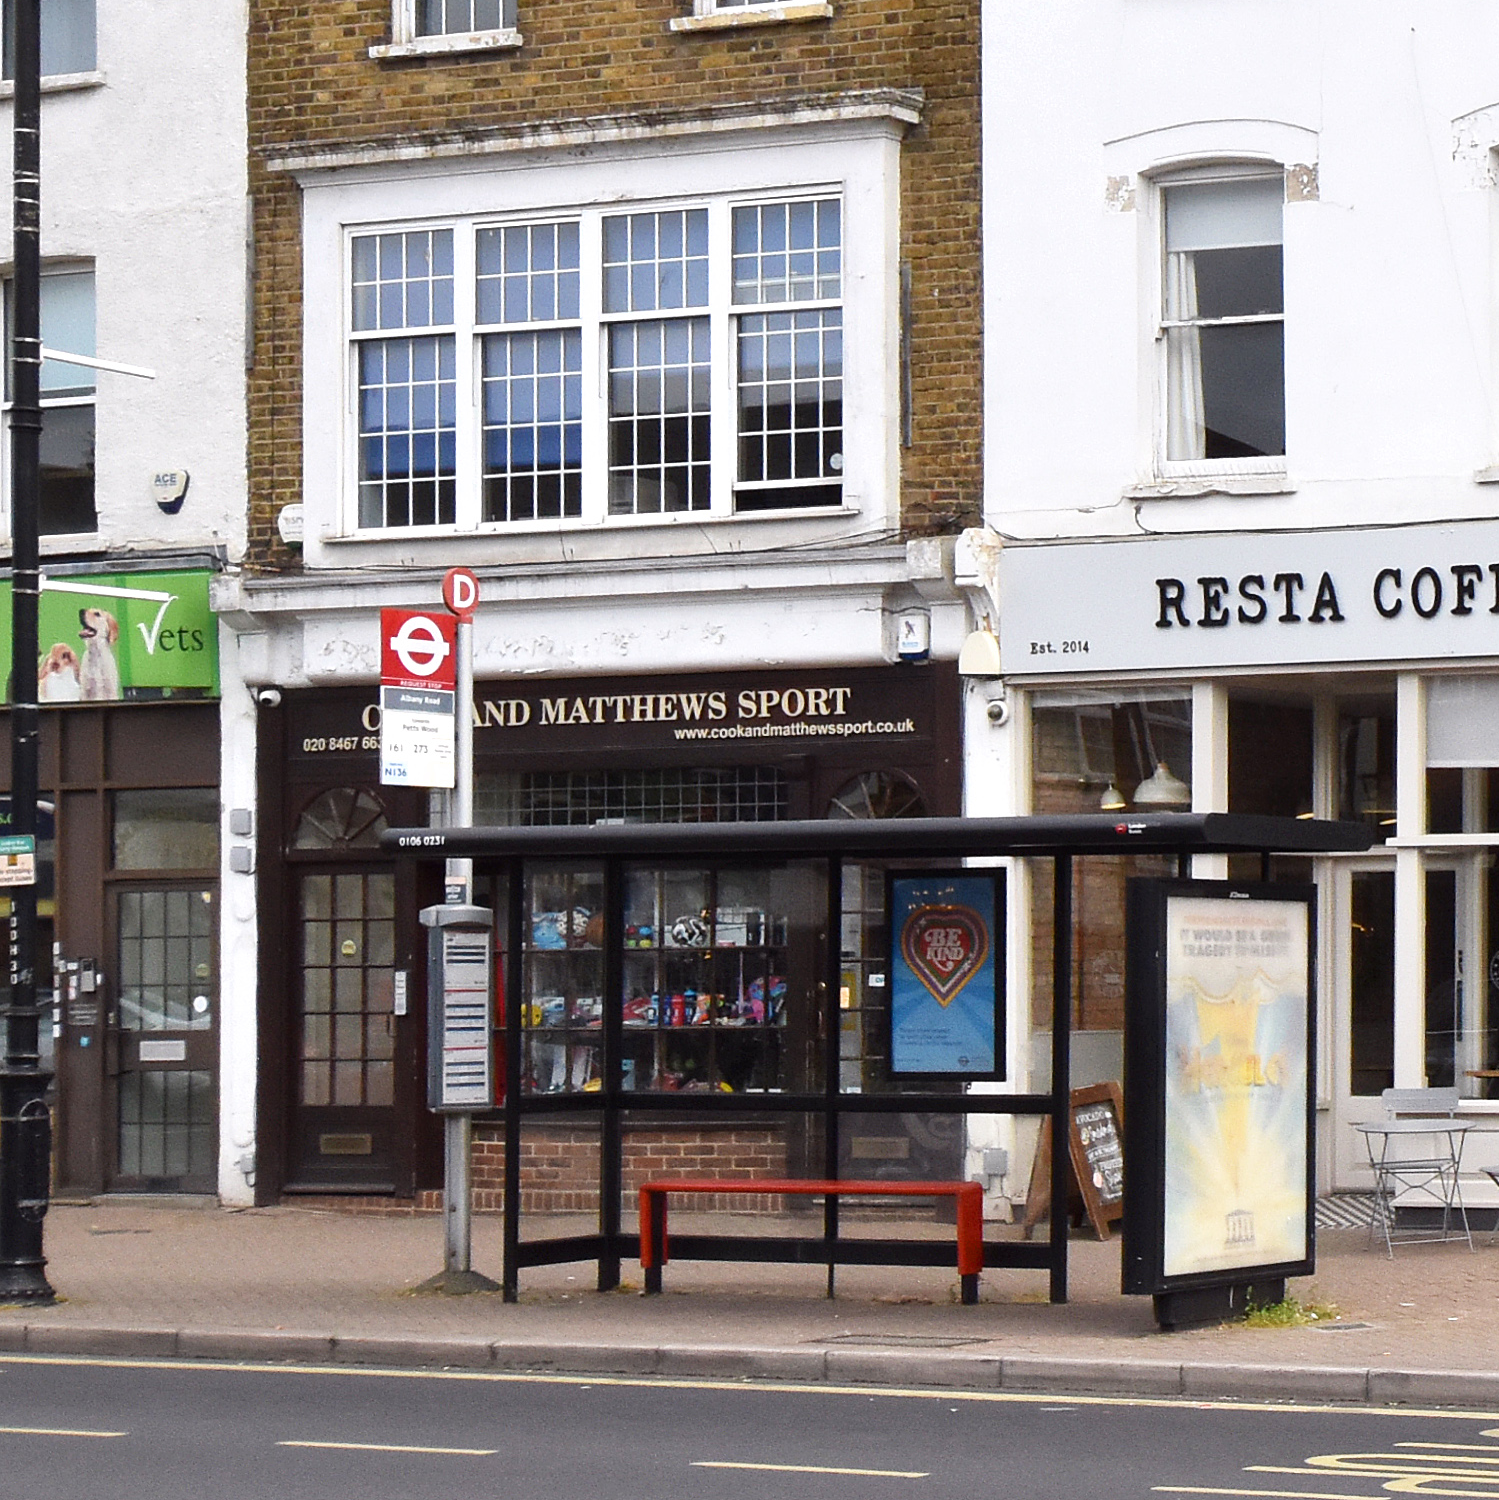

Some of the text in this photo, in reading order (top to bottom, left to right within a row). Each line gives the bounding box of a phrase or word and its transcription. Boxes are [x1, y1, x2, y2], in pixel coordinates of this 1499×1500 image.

[154, 473, 177, 484] ACE
[453, 574, 475, 608] D
[1155, 570, 1345, 628] RESTA
[1030, 640, 1089, 655] Est. 2014
[424, 696, 441, 706] Road
[539, 691, 727, 725] MATTHEWS
[738, 687, 851, 718] SPORT
[674, 718, 915, 740] www.cookandmatthewssport.co.uk
[303, 736, 381, 752] 020 8467 66
[413, 744, 429, 754] 273
[399, 835, 445, 846] 0106 0231
[924, 927, 962, 947] BE
[926, 946, 964, 972] KIND
